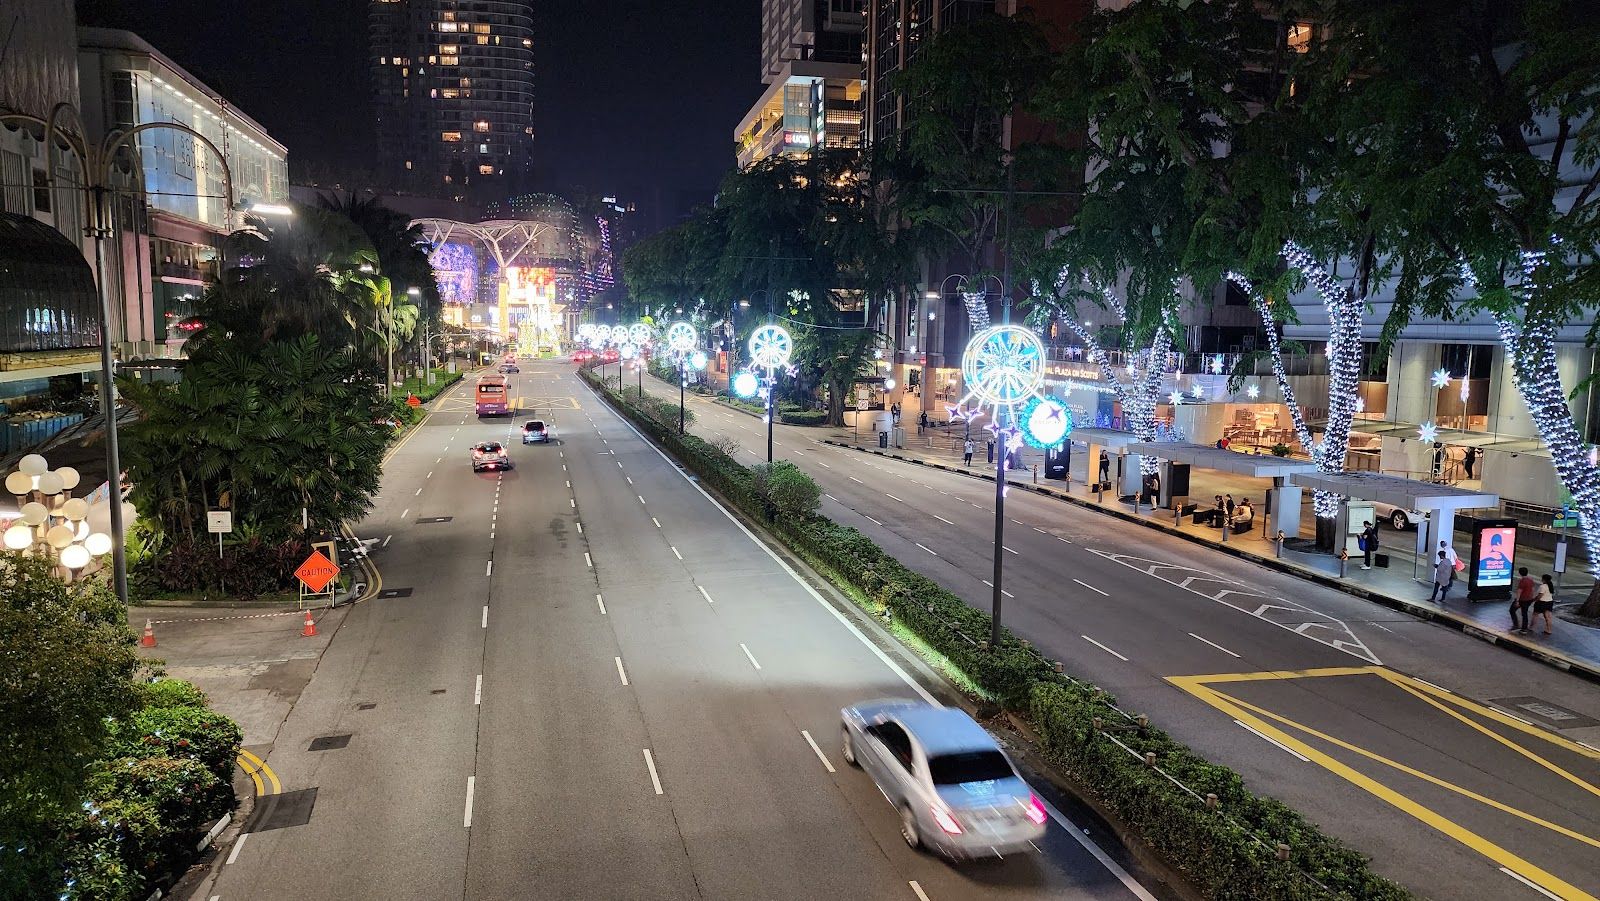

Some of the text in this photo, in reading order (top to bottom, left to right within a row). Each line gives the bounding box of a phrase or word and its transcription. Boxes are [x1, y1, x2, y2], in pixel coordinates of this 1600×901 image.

[180, 135, 208, 160] SCOTTS
[181, 151, 209, 175] SQUARE
[1054, 366, 1071, 377] PLAZA
[1080, 369, 1099, 380] SCOTTS
[301, 566, 333, 577] CAUTION
